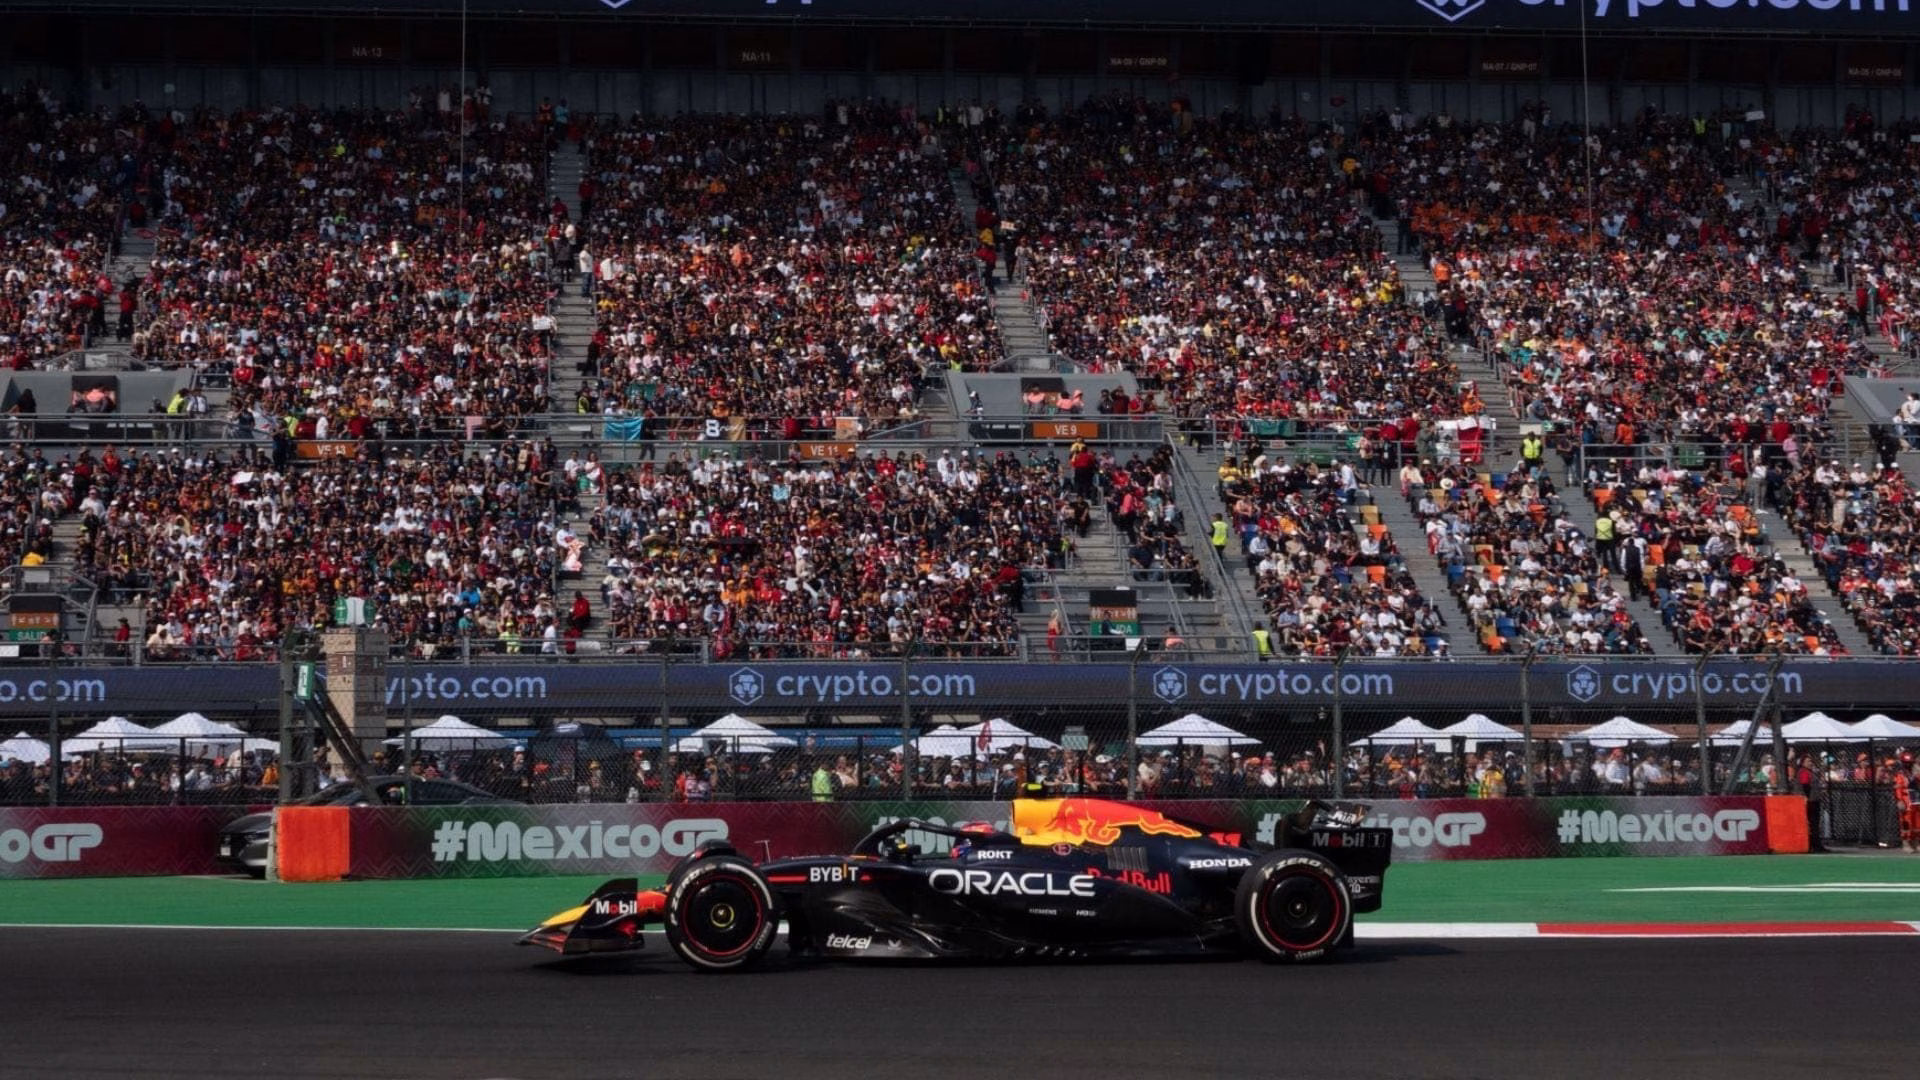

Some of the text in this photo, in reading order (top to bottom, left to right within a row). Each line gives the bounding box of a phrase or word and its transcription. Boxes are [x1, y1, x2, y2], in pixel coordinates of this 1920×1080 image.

[1054, 424, 1077, 435] VE 9
[810, 445, 825, 456] VE
[776, 670, 975, 702] crypto.com
[1199, 669, 1393, 700] crypto.com
[1612, 668, 1803, 699] crypto.com
[1557, 809, 1760, 844] #MexicoGP
[1312, 832, 1365, 848] Mobil
[977, 850, 1014, 861] ROKT
[1188, 857, 1253, 870] HONDA
[1275, 857, 1322, 871] ZERO
[810, 863, 859, 882] BYBIT
[928, 868, 1096, 897] ORACLE
[1131, 871, 1171, 893] Bull
[596, 900, 637, 914] Mobil
[826, 932, 872, 950] telcel
